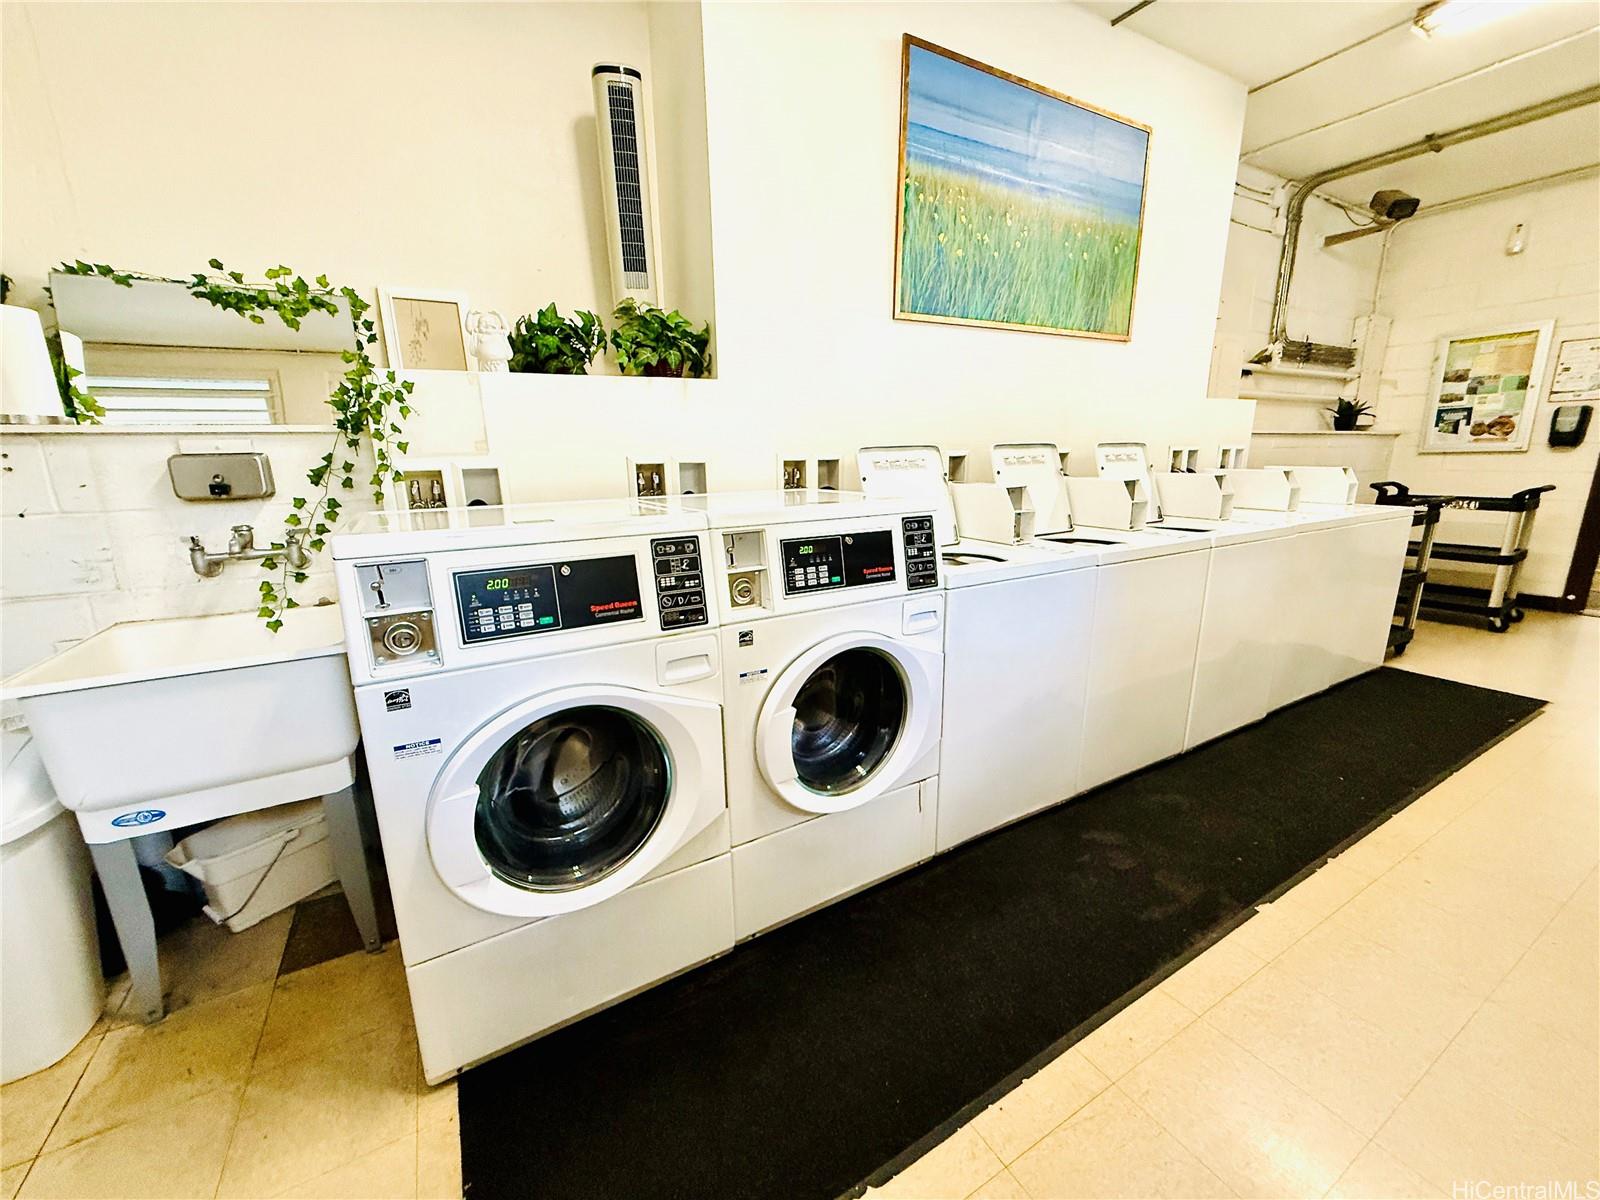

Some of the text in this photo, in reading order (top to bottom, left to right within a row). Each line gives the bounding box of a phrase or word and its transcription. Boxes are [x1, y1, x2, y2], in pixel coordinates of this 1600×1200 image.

[486, 578, 509, 590] 2.00
[590, 600, 638, 612] Speed Queen
[405, 740, 430, 749] NOTICE
